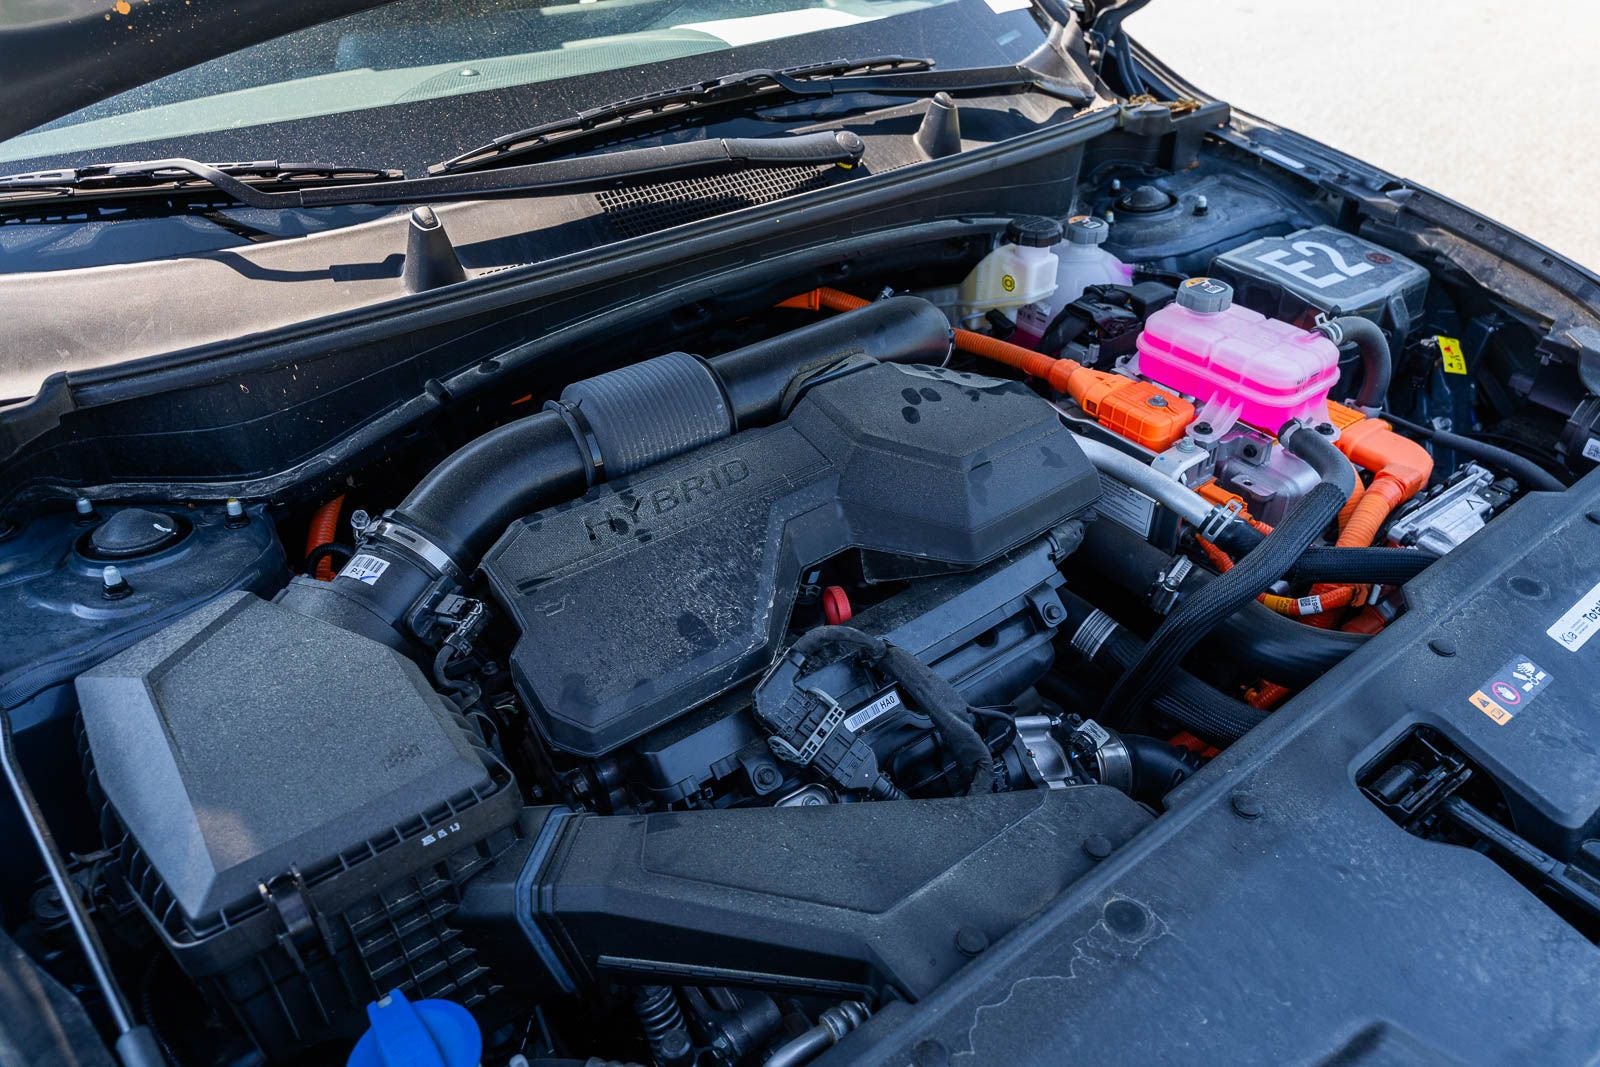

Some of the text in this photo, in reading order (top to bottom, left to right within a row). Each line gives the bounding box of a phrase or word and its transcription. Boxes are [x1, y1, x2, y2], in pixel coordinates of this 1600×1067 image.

[1255, 241, 1375, 288] E2
[583, 456, 749, 541] HYBRID
[1559, 631, 1578, 645] Kia
